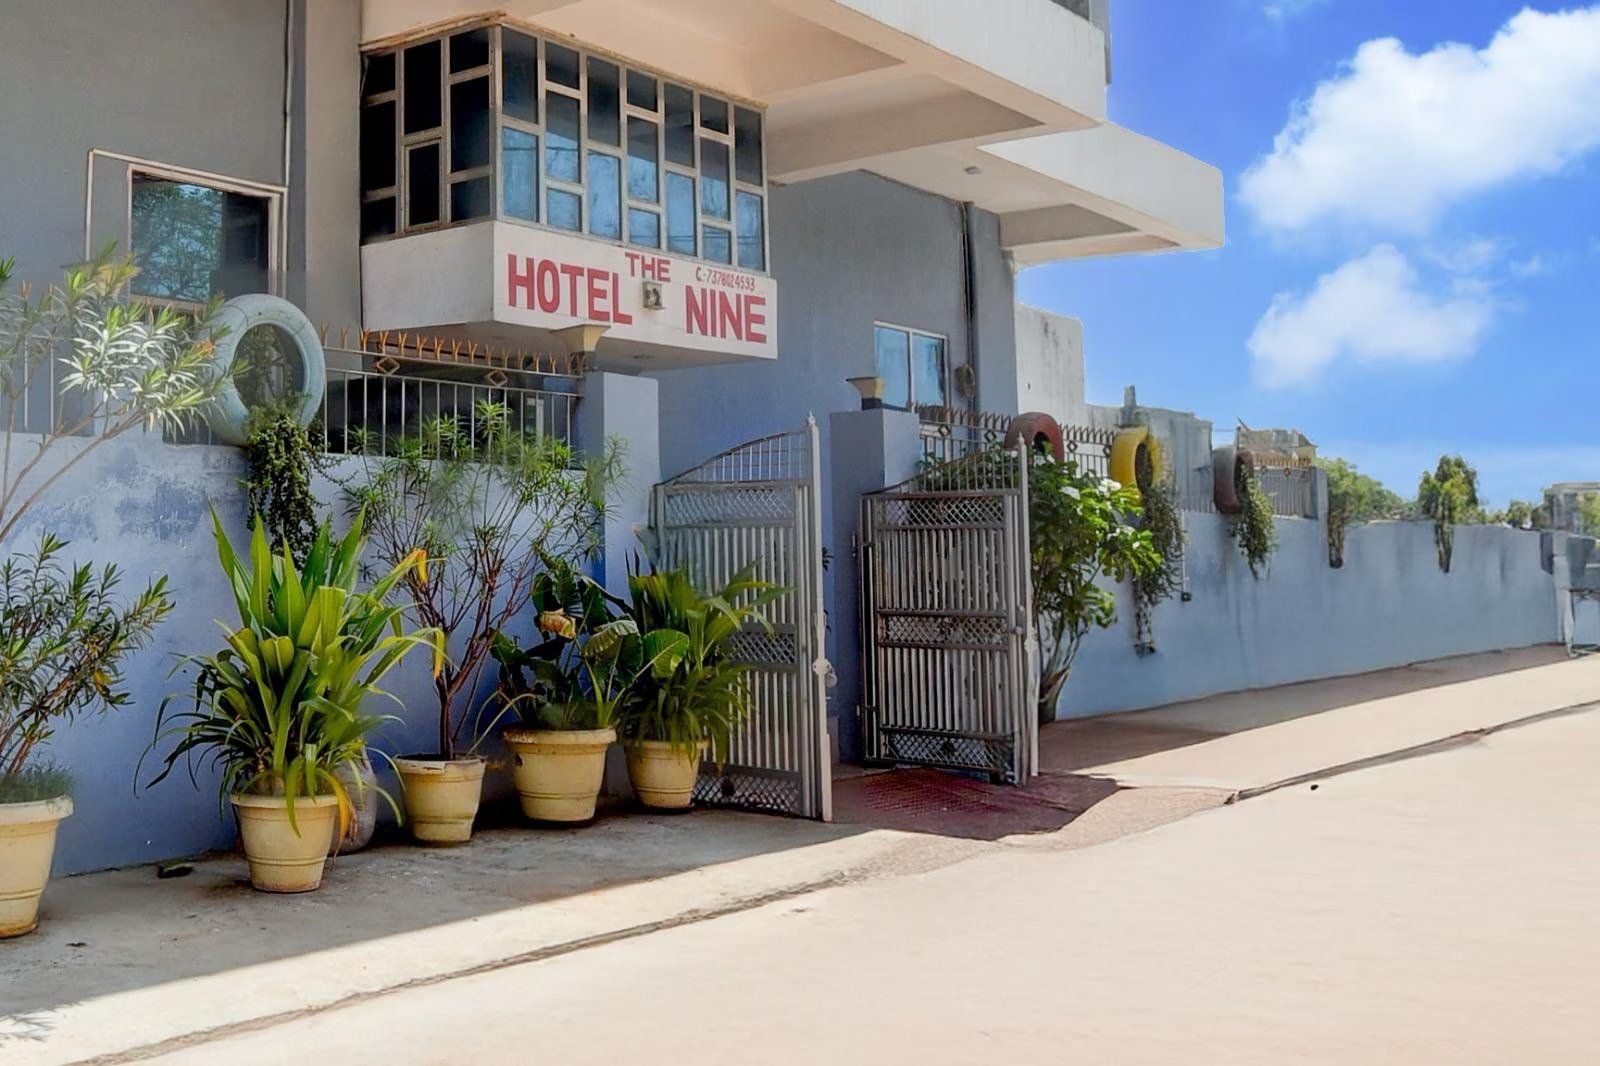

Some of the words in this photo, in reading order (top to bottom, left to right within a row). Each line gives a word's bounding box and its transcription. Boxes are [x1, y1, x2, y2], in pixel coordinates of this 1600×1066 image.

[624, 252, 671, 282] THE
[507, 253, 633, 326] HOTEL
[684, 285, 767, 344] NINE
